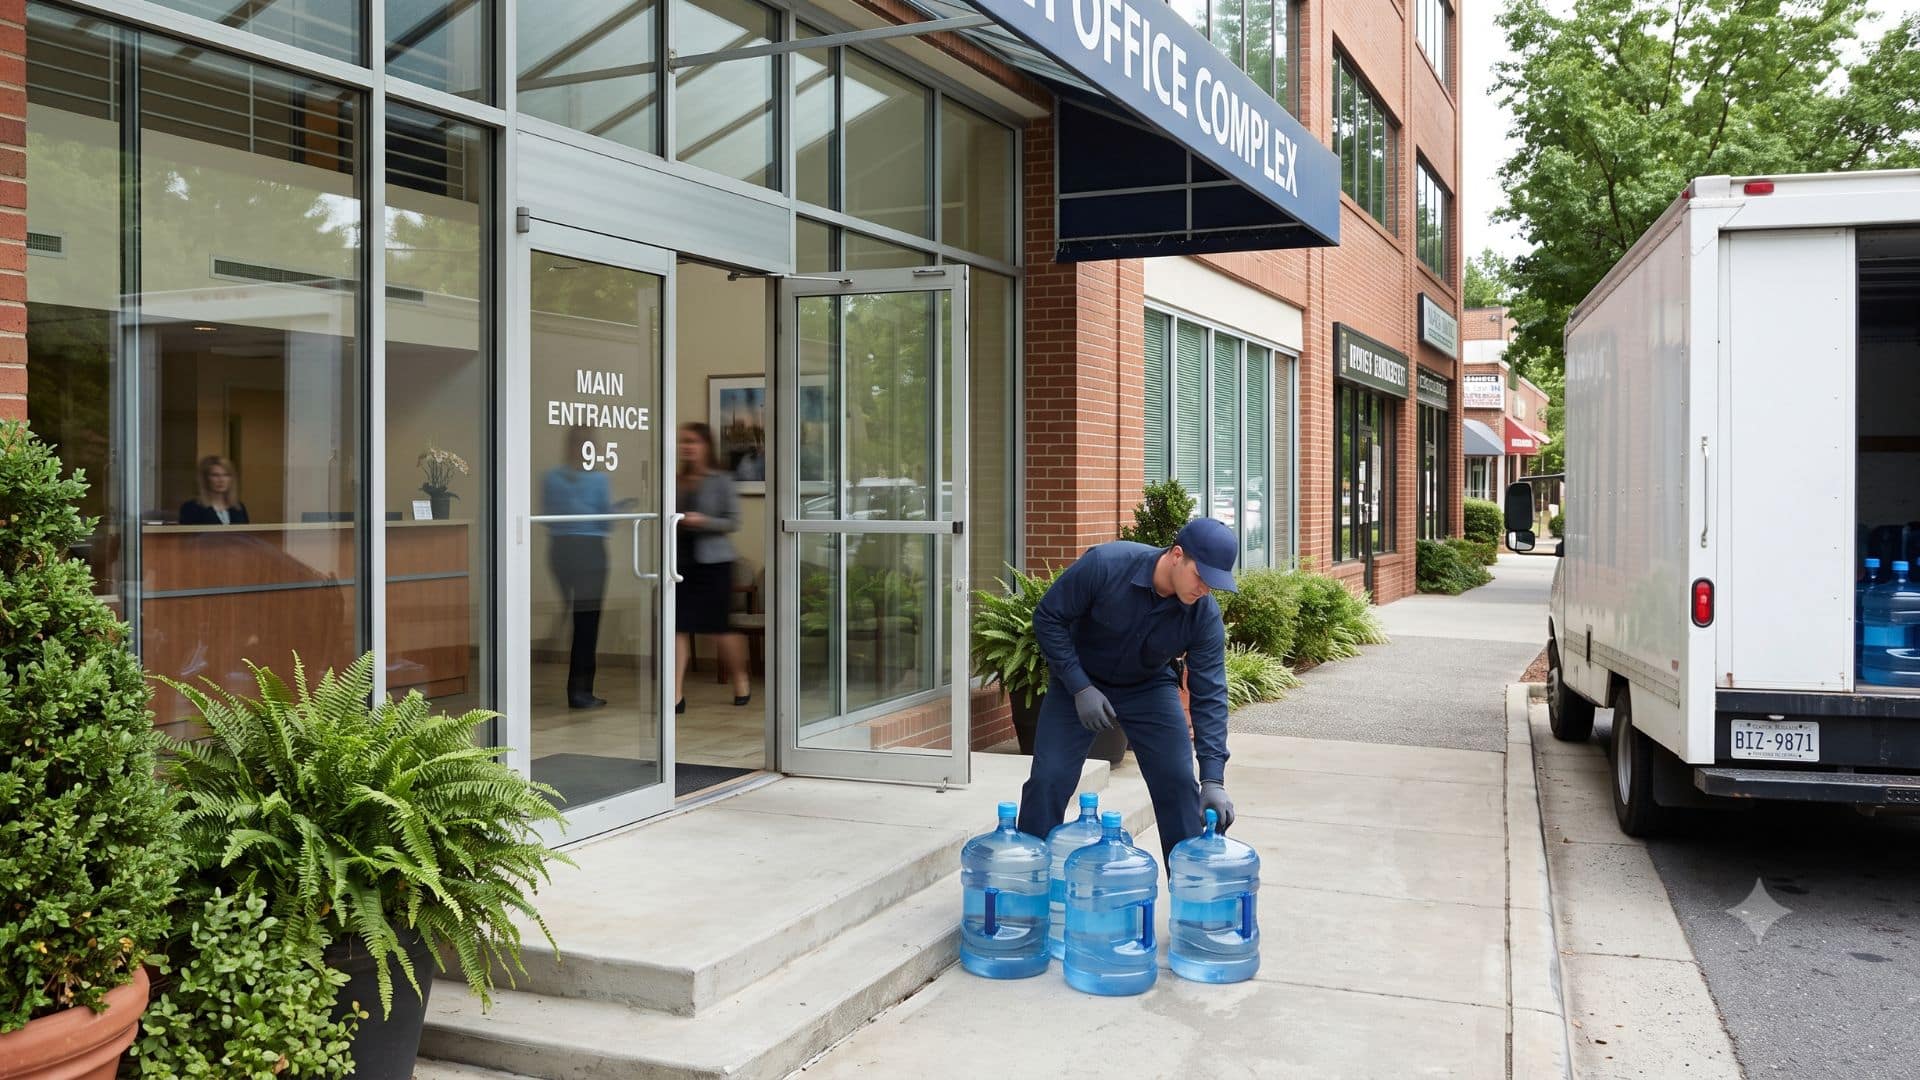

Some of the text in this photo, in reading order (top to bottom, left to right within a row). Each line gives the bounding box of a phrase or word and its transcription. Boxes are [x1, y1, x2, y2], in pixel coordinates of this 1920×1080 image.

[1072, 0, 1298, 198] OFFICE COMPLEX
[576, 369, 624, 397] MAIN
[548, 400, 649, 430] ENTRANCE
[581, 440, 618, 471] 9-5
[1735, 731, 1814, 752] BIZ-9871
